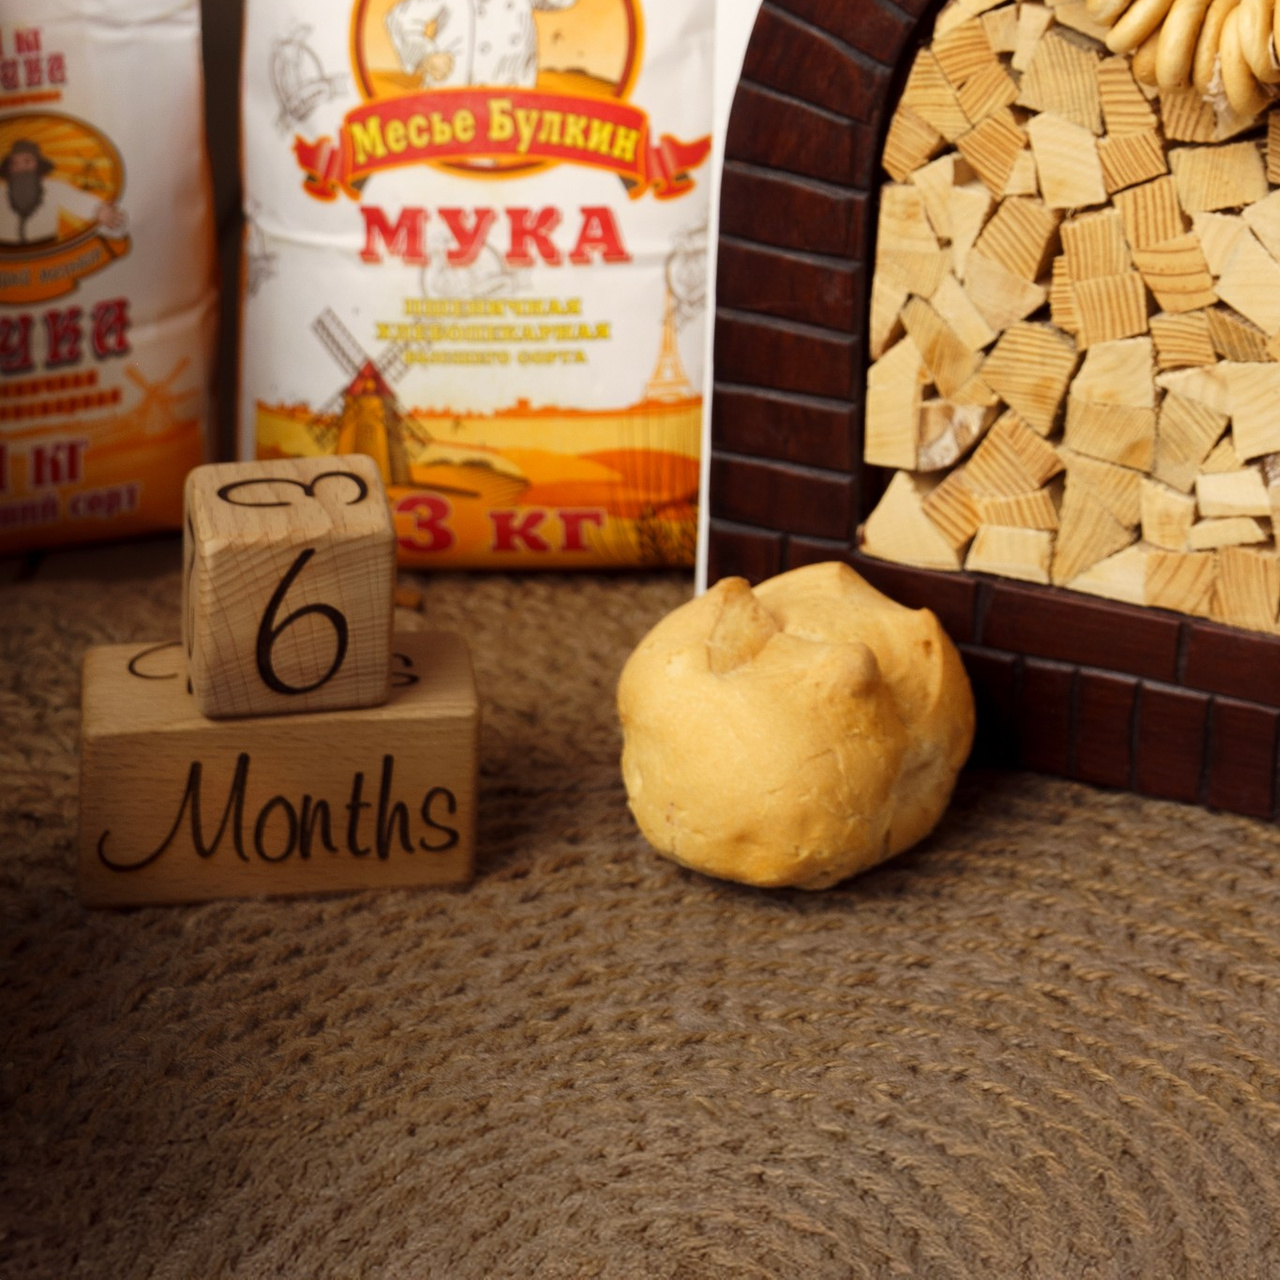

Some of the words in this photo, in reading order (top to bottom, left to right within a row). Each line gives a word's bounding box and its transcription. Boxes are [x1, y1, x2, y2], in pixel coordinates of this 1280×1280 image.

[351, 114, 476, 165] Месье
[488, 97, 640, 163] Булкин
[358, 206, 632, 267] МУКА
[396, 493, 456, 554] 3
[256, 547, 349, 696] 6
[97, 752, 460, 872] Months
